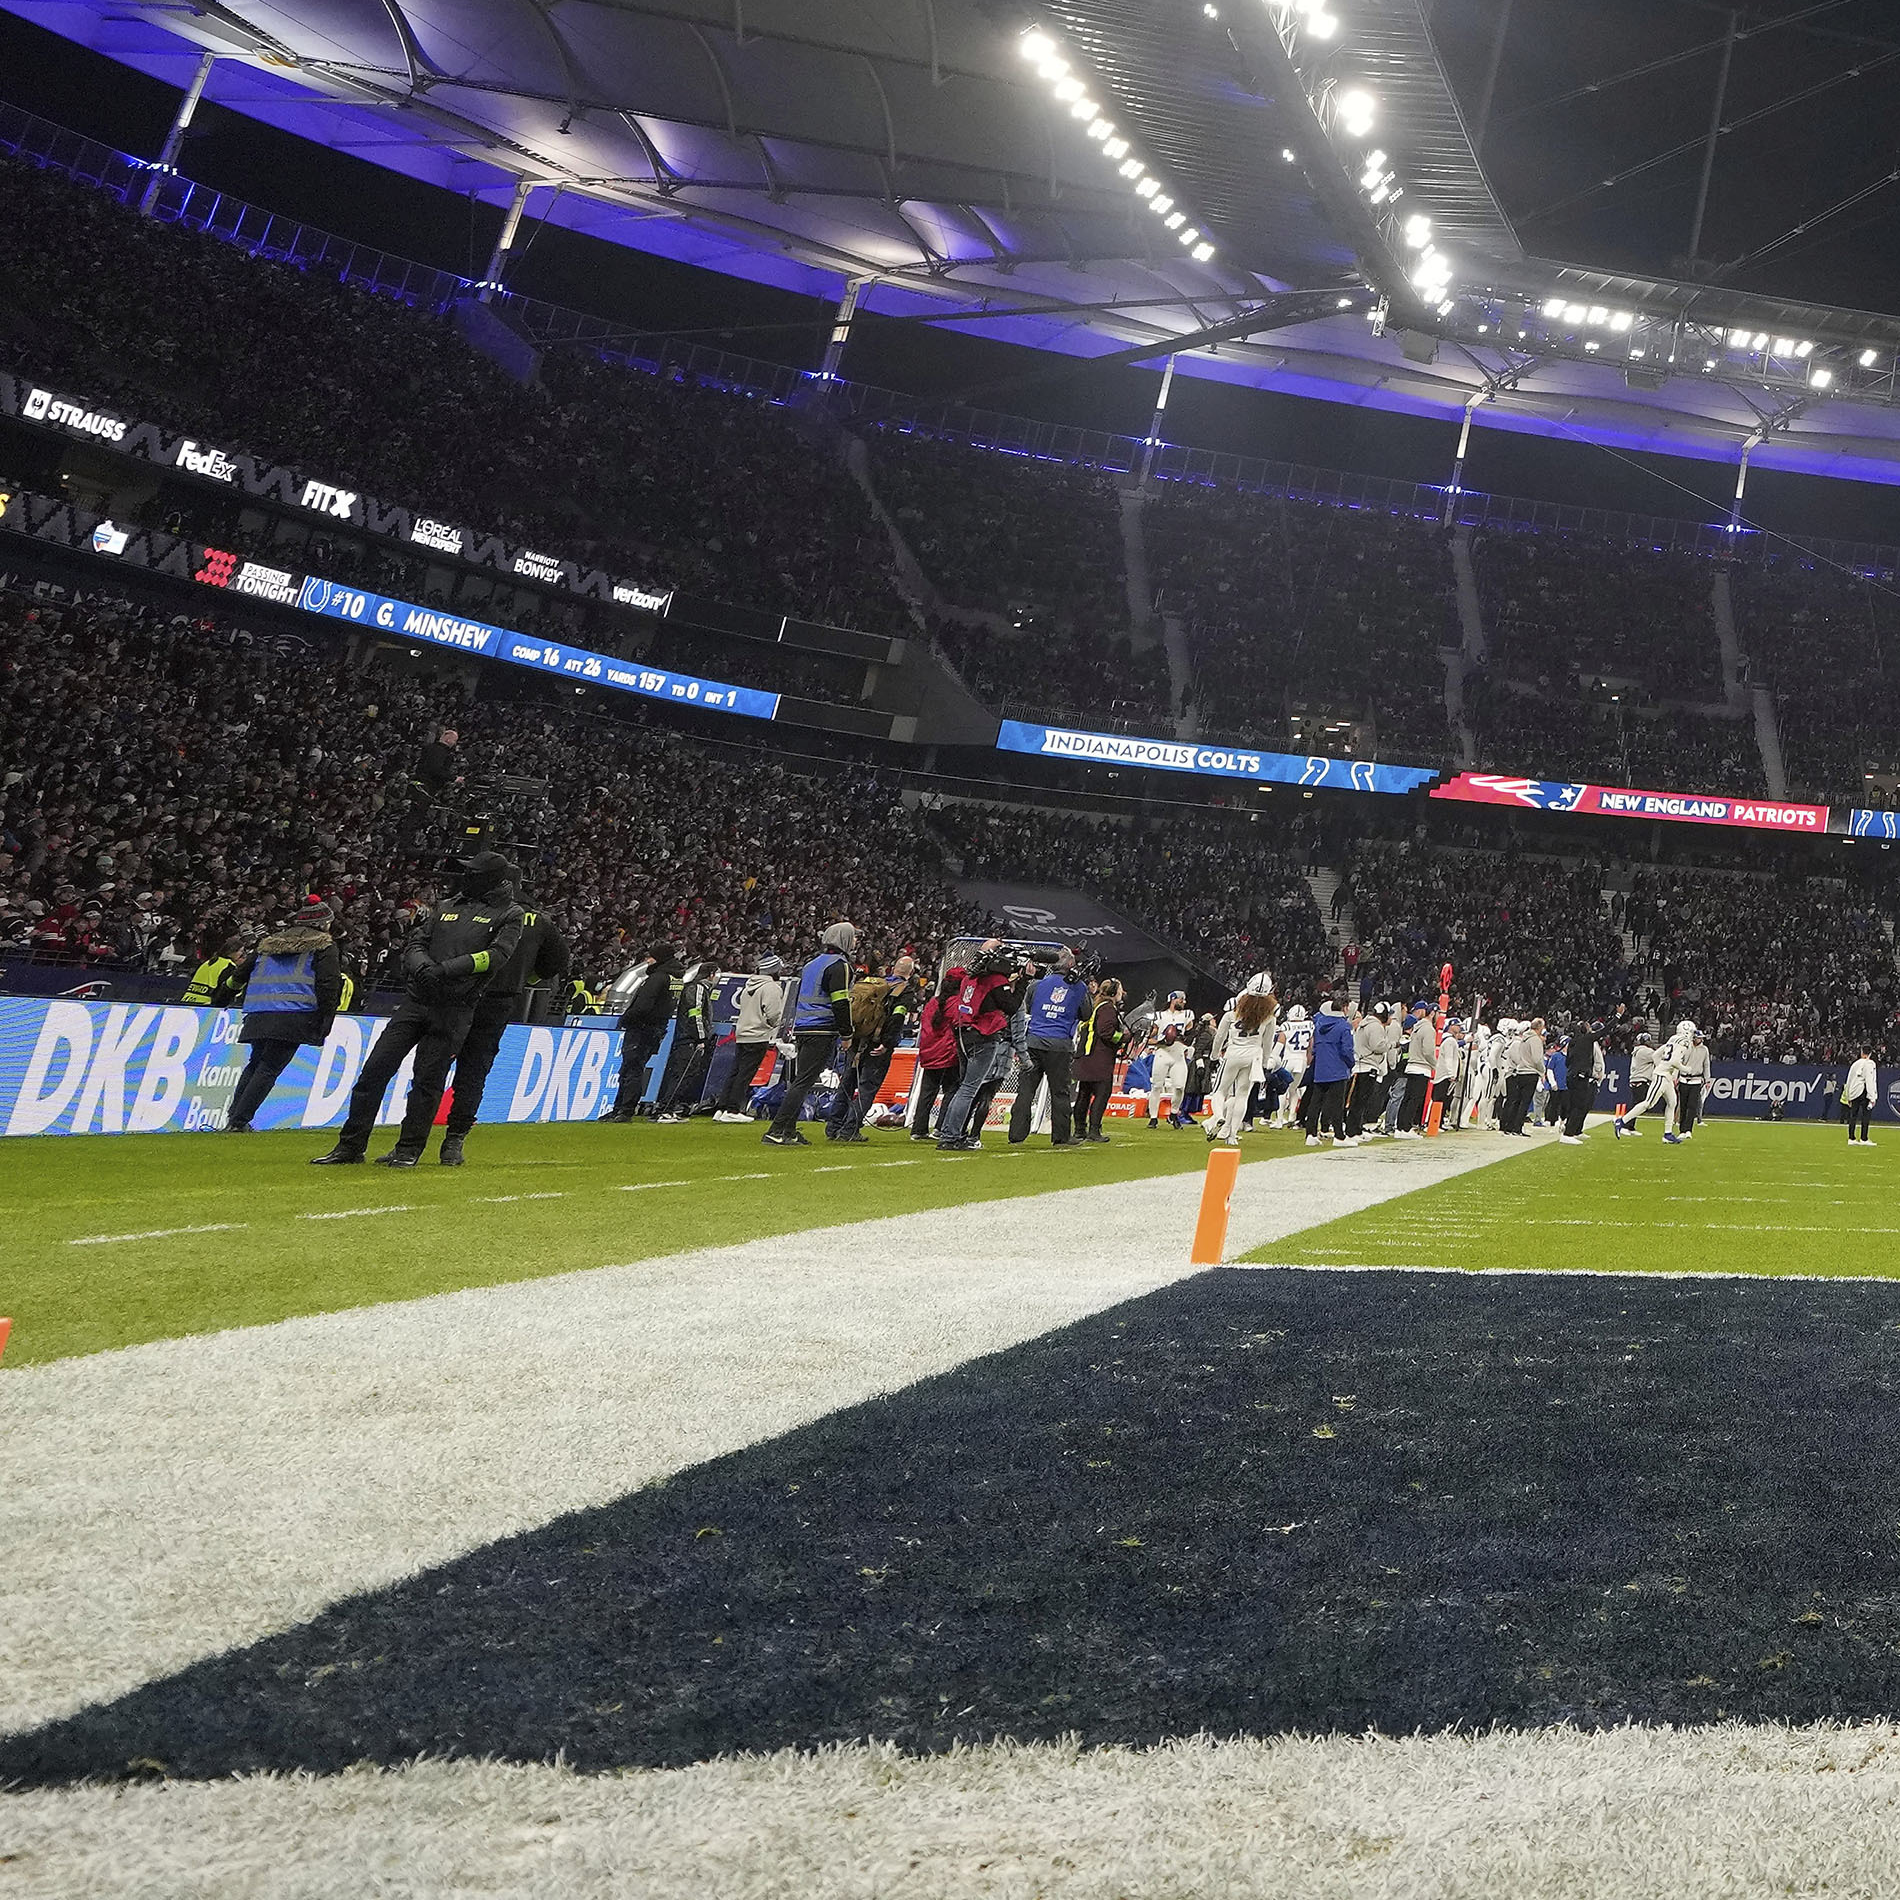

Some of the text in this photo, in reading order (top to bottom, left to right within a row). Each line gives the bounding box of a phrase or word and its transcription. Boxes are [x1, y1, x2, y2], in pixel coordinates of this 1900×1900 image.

[48, 400, 126, 441] STRAUSS
[176, 440, 237, 481] FedEx
[245, 564, 286, 584] PASSING
[514, 559, 564, 584] BONVOY
[525, 551, 560, 568] MARRIOTT
[236, 574, 299, 605] TONIGHT
[332, 590, 366, 619] #10
[613, 586, 660, 611] verizon
[376, 602, 492, 650] G. MINSHEW
[512, 645, 541, 661] COMP
[543, 647, 560, 666] 16
[564, 659, 583, 673] ATT
[583, 657, 602, 677] 26
[607, 669, 637, 686] YARDS
[639, 672, 667, 692] 157
[672, 684, 686, 697] TD
[726, 690, 738, 707] 1
[1050, 733, 1261, 773] INDIANAPOLIS COLTS
[1601, 793, 1816, 826] NEW ENGLAND PATRIOTS
[1288, 1030, 1311, 1051] 43
[4, 1001, 200, 1137] DKB
[507, 1027, 610, 1123] DKB
